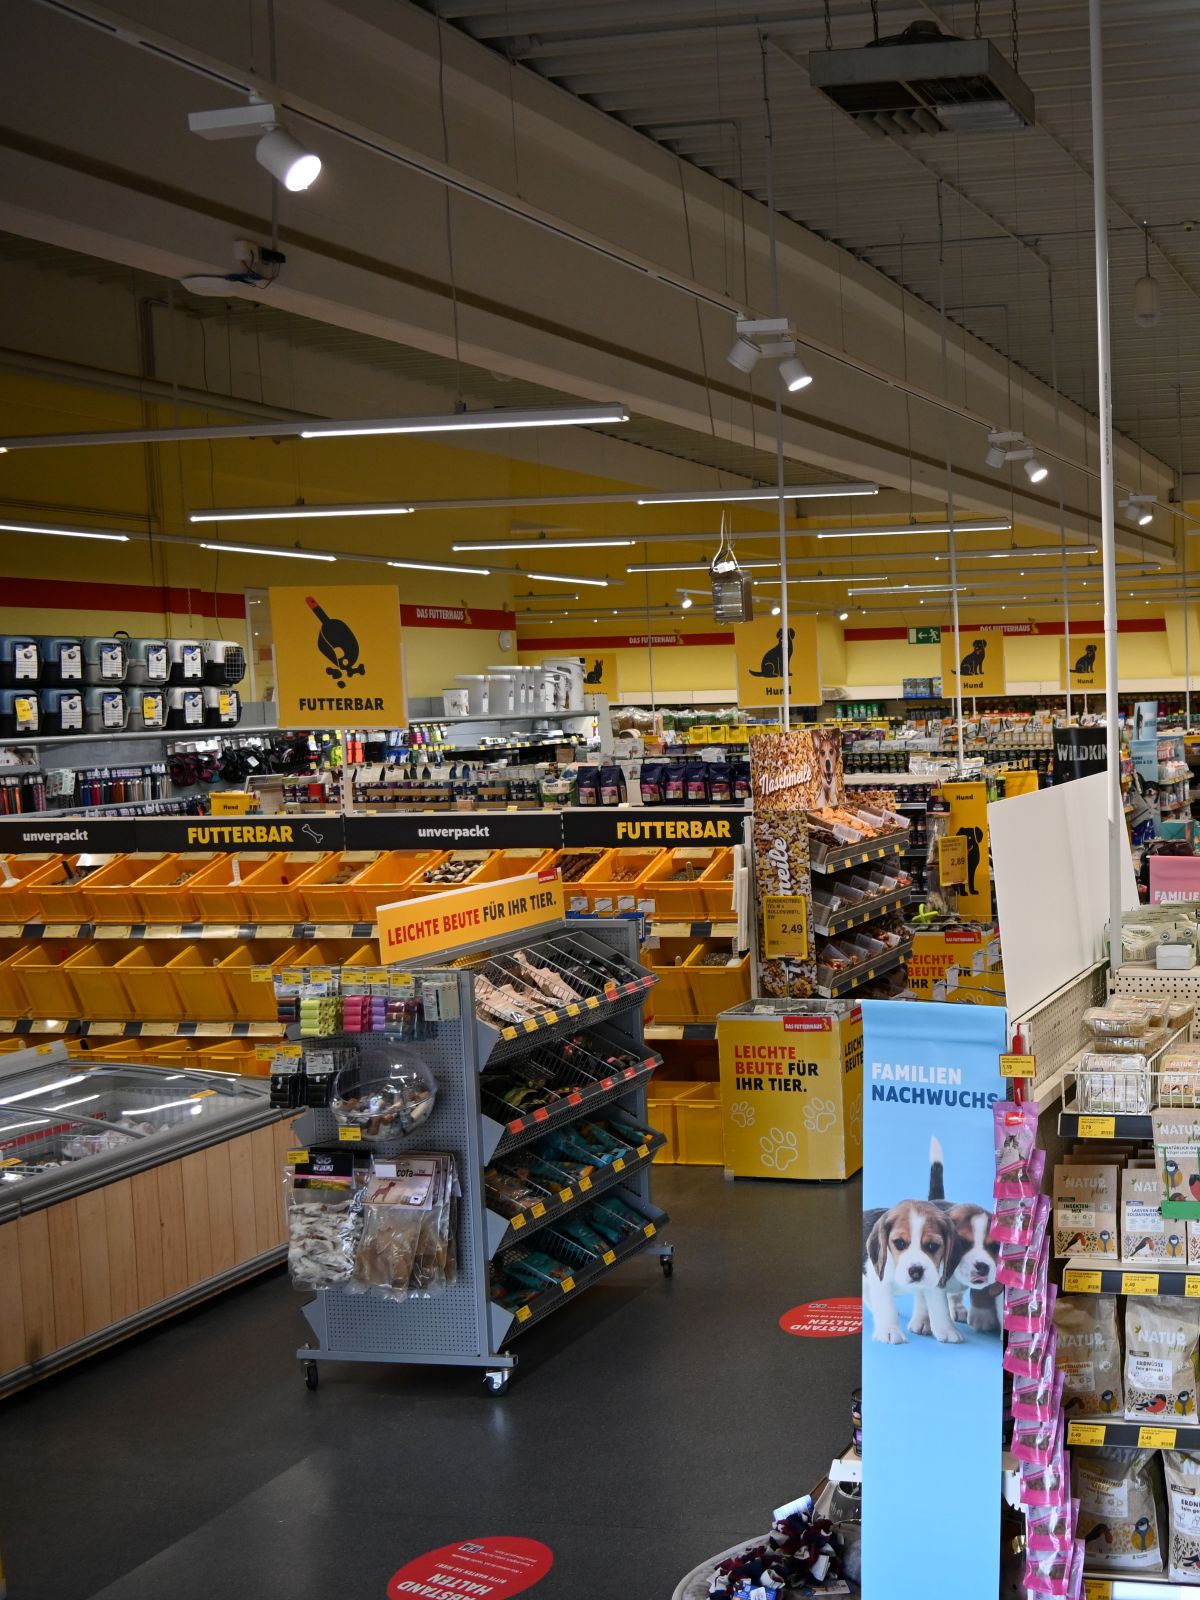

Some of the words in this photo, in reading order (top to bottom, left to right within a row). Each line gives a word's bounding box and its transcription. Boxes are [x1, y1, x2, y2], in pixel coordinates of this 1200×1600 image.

[416, 608, 427, 618] DAS
[429, 609, 463, 620] FUTTERHAUS
[963, 681, 984, 689] Hund
[299, 697, 384, 711] FUTTERBAR
[1057, 743, 1107, 761] WILDKIN
[759, 763, 812, 795] Naschmeile
[222, 803, 239, 811] Hund
[23, 828, 88, 843] unverpackt
[187, 825, 293, 844] FUTTERBAR
[418, 825, 490, 840] unverpackt
[617, 820, 731, 840] FUTTERBAR
[951, 857, 965, 866] 2,89
[388, 919, 440, 947] LEICHTE
[443, 908, 480, 933] BEUTE
[483, 900, 505, 923] FÜR
[508, 899, 528, 918] IHR
[530, 891, 557, 915] TIER.
[781, 924, 803, 935] 2,49
[734, 1045, 796, 1060] LEICHTE
[735, 1062, 783, 1076] BEUTE
[788, 1061, 819, 1077] FÜR
[871, 1063, 962, 1086] FAMILIEN
[736, 1077, 763, 1091] IHR
[768, 1078, 807, 1093] TIER.
[872, 1085, 998, 1109] NACHWUCHS
[1065, 1177, 1106, 1188] NATUR
[790, 1324, 858, 1332] ABSTAND
[1138, 1330, 1186, 1345] NATUR
[1136, 1360, 1164, 1368] ERDNÜSSE
[427, 1573, 494, 1596] HALTEN
